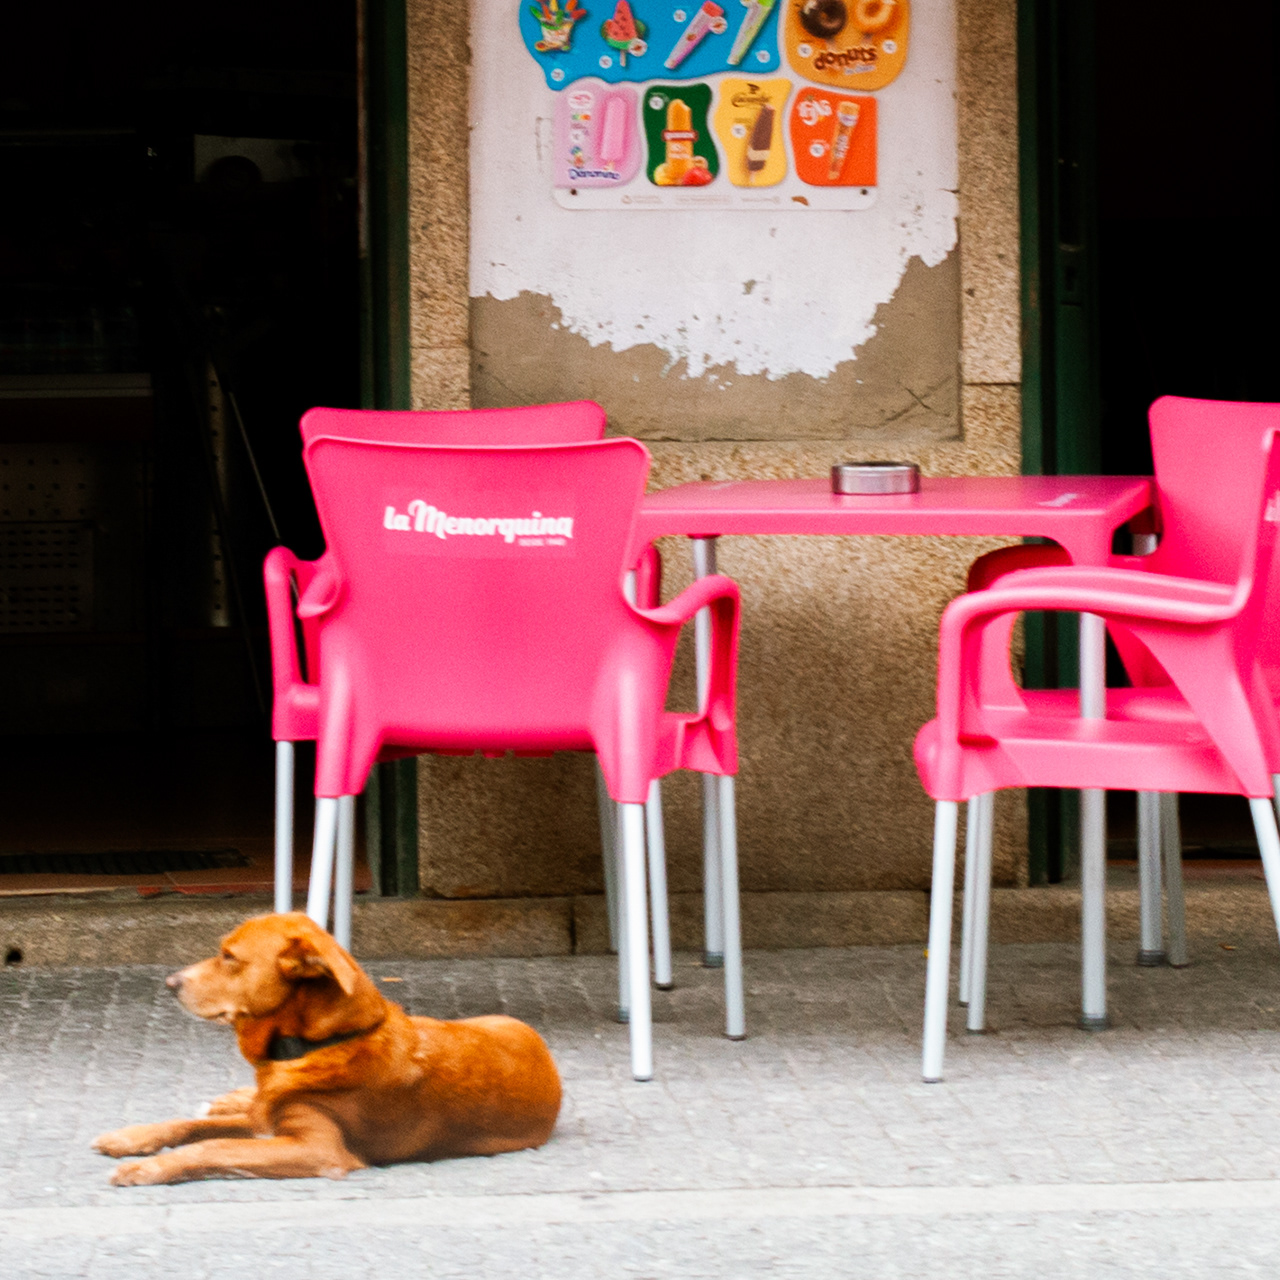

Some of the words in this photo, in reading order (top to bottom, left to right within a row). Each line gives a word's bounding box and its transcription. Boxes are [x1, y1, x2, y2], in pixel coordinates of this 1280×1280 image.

[814, 47, 877, 70] donuts
[383, 505, 411, 531] la
[407, 499, 574, 544] Menorquina
